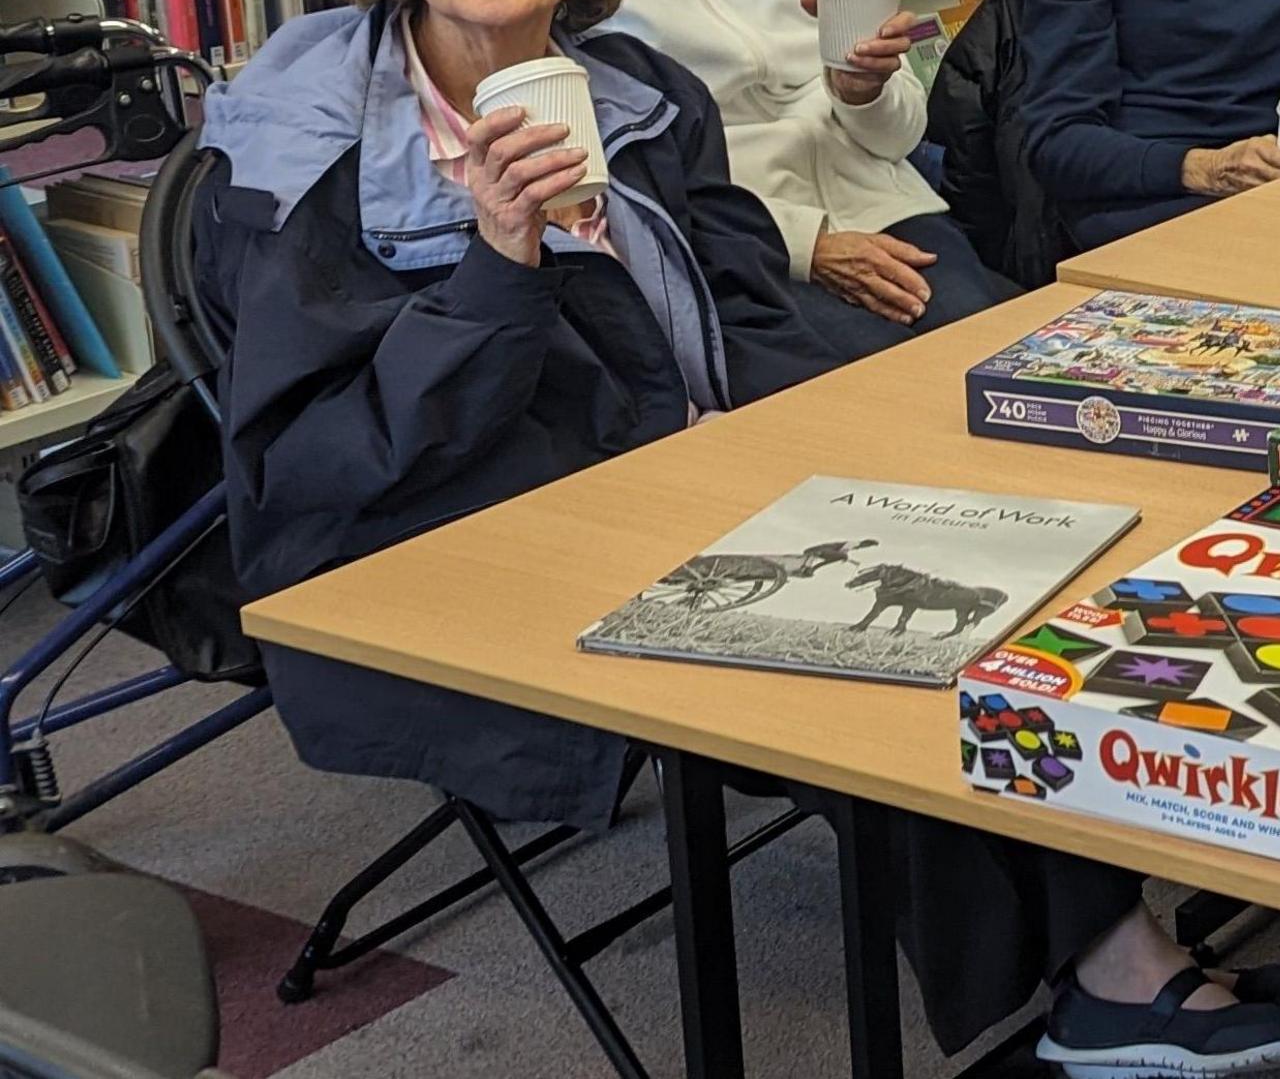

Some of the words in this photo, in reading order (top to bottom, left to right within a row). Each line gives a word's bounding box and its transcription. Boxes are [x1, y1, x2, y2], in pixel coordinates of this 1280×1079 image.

[999, 399, 1027, 420] 40
[1142, 424, 1168, 439] Happy
[1169, 428, 1176, 437] &
[1176, 428, 1207, 441] Glorious
[830, 492, 856, 507] A
[865, 493, 955, 517] World
[961, 505, 997, 519] of
[998, 508, 1079, 531] Work
[891, 511, 910, 522] in
[912, 513, 990, 531] pictures
[994, 651, 1039, 667] OVER
[978, 659, 1004, 672] 4
[1001, 666, 1067, 686] MILLION
[1008, 678, 1058, 692] SOLD!
[1126, 791, 1149, 806] MIX,
[1151, 798, 1190, 816] MATCH,
[1193, 808, 1229, 824] SCORE
[1231, 817, 1256, 831] AND
[1176, 816, 1211, 832] PLAYERS
